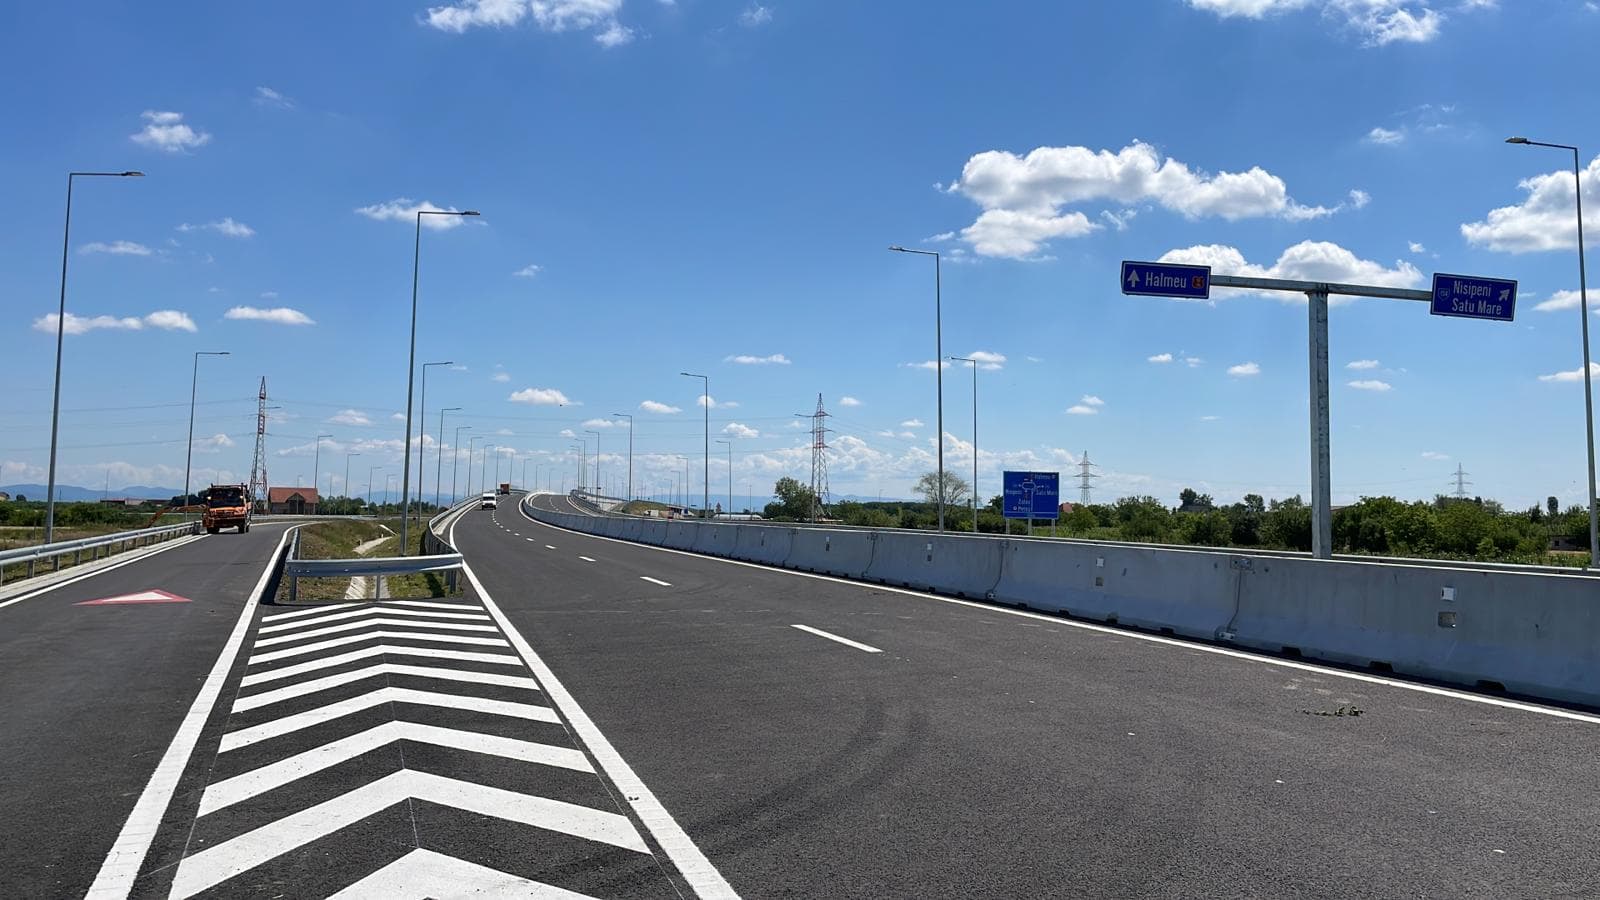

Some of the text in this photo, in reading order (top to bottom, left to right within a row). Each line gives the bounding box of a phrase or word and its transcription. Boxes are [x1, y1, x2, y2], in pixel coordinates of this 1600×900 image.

[1145, 271, 1187, 289] Halmeu
[1453, 280, 1492, 299] Nisipeni
[1451, 297, 1502, 315] Satu Mare
